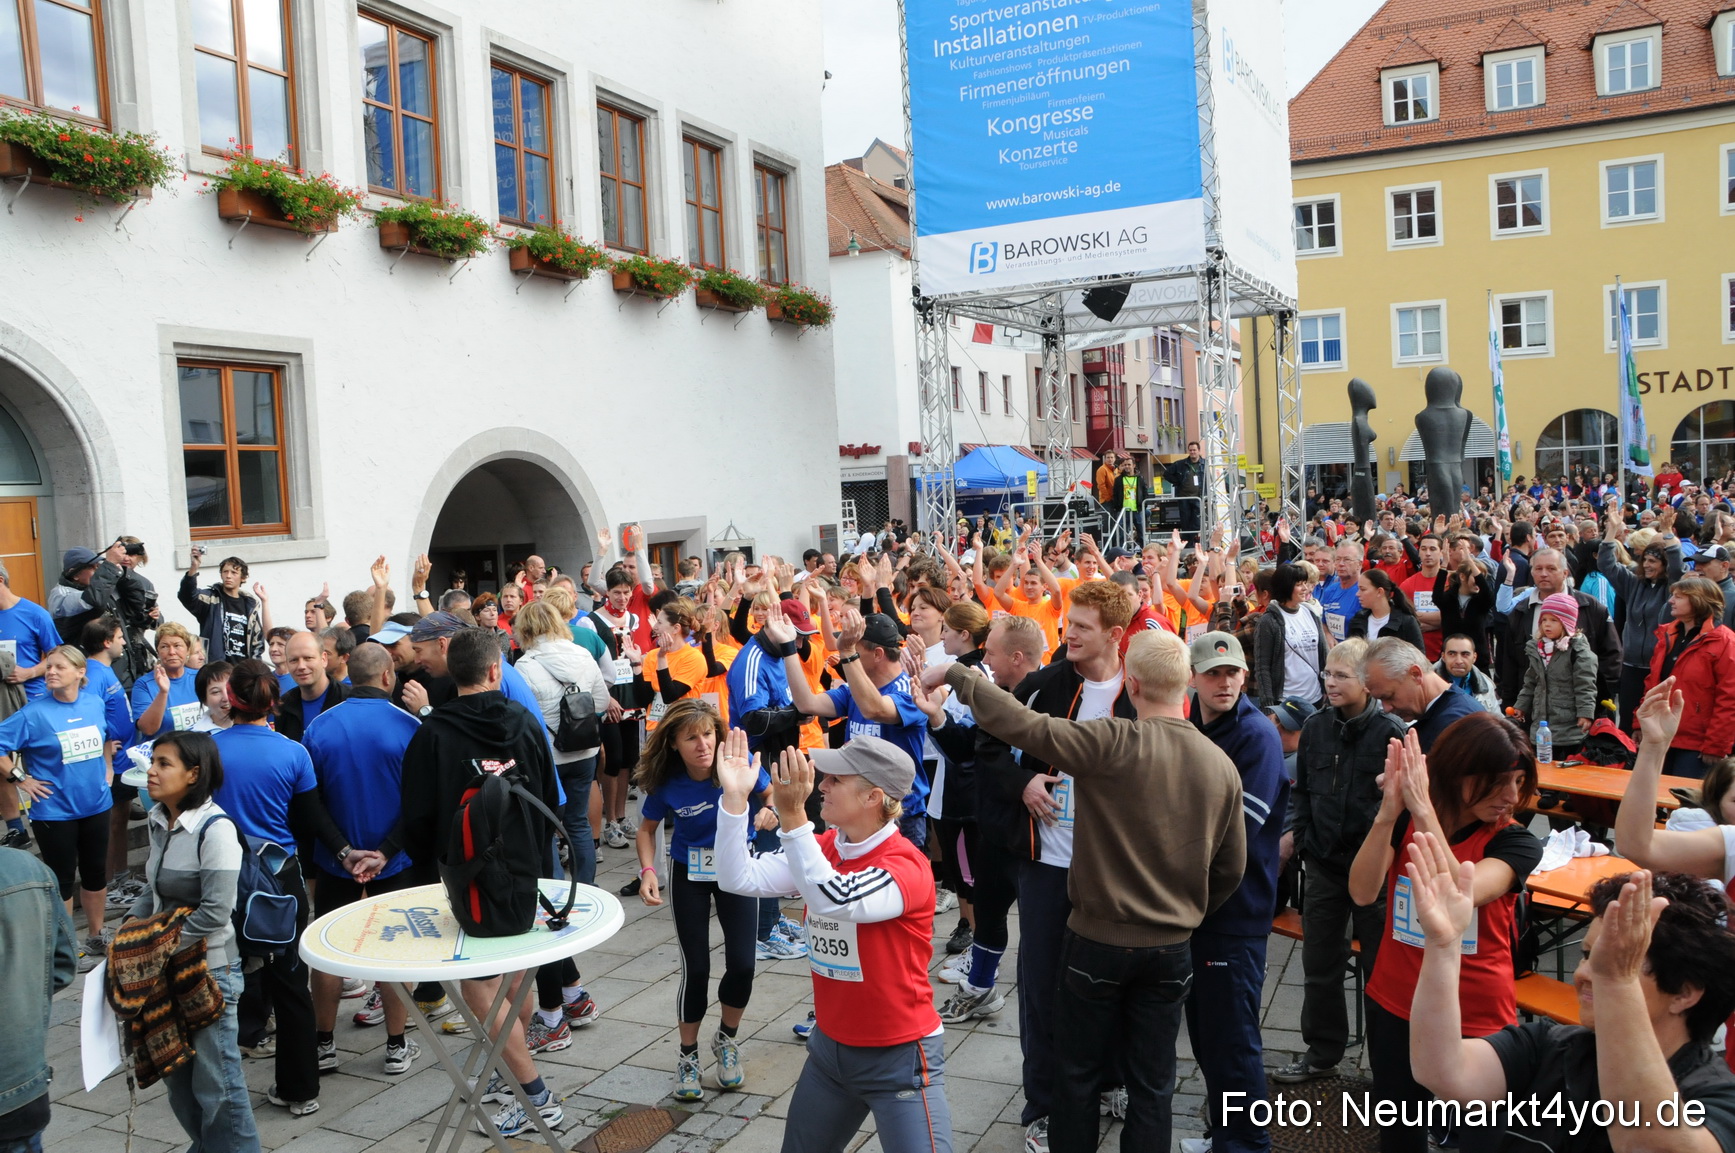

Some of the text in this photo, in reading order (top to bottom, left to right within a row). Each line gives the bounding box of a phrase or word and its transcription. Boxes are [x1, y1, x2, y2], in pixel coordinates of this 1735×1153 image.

[950, 0, 1112, 33] Sportveransta
[1082, 3, 1160, 25] TV-Produktionen
[934, 14, 1079, 58] Installationen
[950, 33, 1090, 71] Kulturveranstaltungen
[973, 40, 1142, 80] Fashionshows Produktpräsentationen
[959, 58, 1131, 102] Firmeneröffnungen
[982, 90, 1050, 110] Firmenjubiläum
[1047, 92, 1106, 109] Firmenfeiern
[987, 105, 1094, 137] Kongresse
[1043, 125, 1089, 141] Musicals
[999, 140, 1079, 165] Konzerte
[1018, 157, 1068, 171] Tourservice
[986, 180, 1122, 210] www.barowski-ag.de
[1004, 226, 1148, 260] BAROWSKI AG
[1005, 247, 1148, 270] Veranstaltungs- und Mediensysteme
[1638, 366, 1734, 394] STADT
[839, 443, 881, 459] Döpfer
[74, 737, 99, 751] 5170
[808, 915, 840, 931] Marliese
[812, 935, 849, 957] 2359
